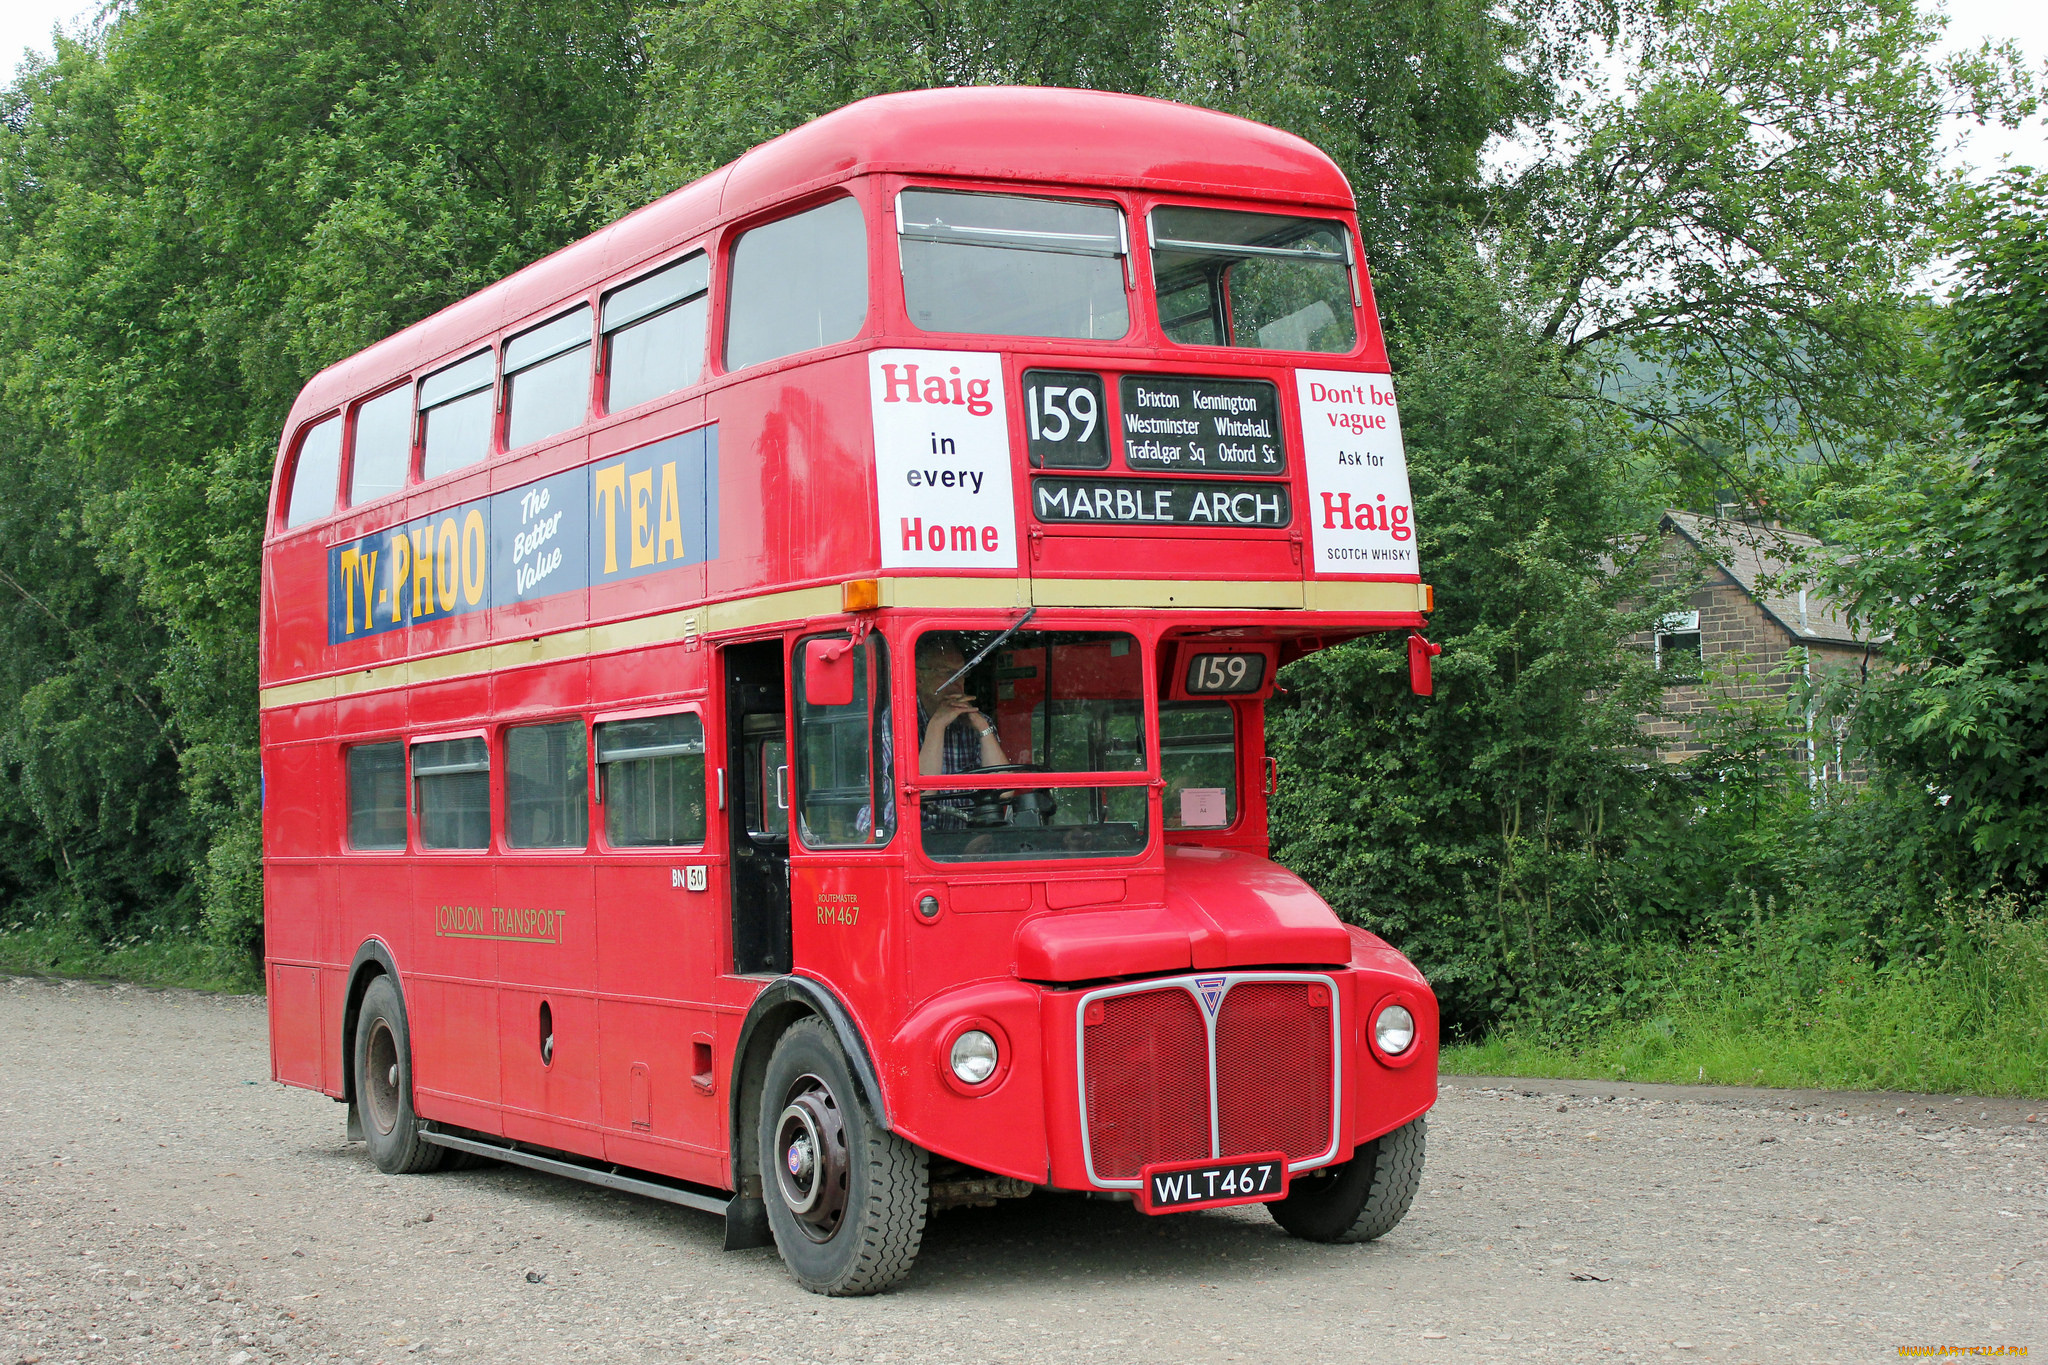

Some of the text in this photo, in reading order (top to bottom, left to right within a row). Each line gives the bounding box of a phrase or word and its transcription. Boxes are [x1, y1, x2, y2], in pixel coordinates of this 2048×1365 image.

[881, 363, 993, 416] Haig
[1137, 387, 1257, 415] Brixton Kennington
[1310, 383, 1395, 406] Don't be
[1028, 385, 1098, 443] 159
[1126, 413, 1271, 439] Westminster Whitehall
[1327, 411, 1387, 436] vague
[931, 432, 956, 456] in
[1126, 439, 1276, 466] Trafalgar Sq Oxford St
[1338, 450, 1385, 468] Ask for
[906, 468, 984, 495] every
[520, 486, 550, 523] The
[595, 460, 685, 575] TEA
[1039, 488, 1280, 523] MARBLE ARCH
[1320, 491, 1410, 541] Haig
[513, 509, 563, 565] Better
[901, 517, 999, 552] Home
[1327, 547, 1411, 562] SCOTCH WHISKY
[516, 546, 562, 596] Value
[1198, 656, 1247, 689] 159
[672, 869, 703, 887] BN 50
[818, 893, 858, 903] ROUTEMASTER
[435, 905, 566, 945] LONDON TRANSPORT
[817, 906, 860, 925] RM 467
[1155, 1165, 1272, 1203] WLT467
